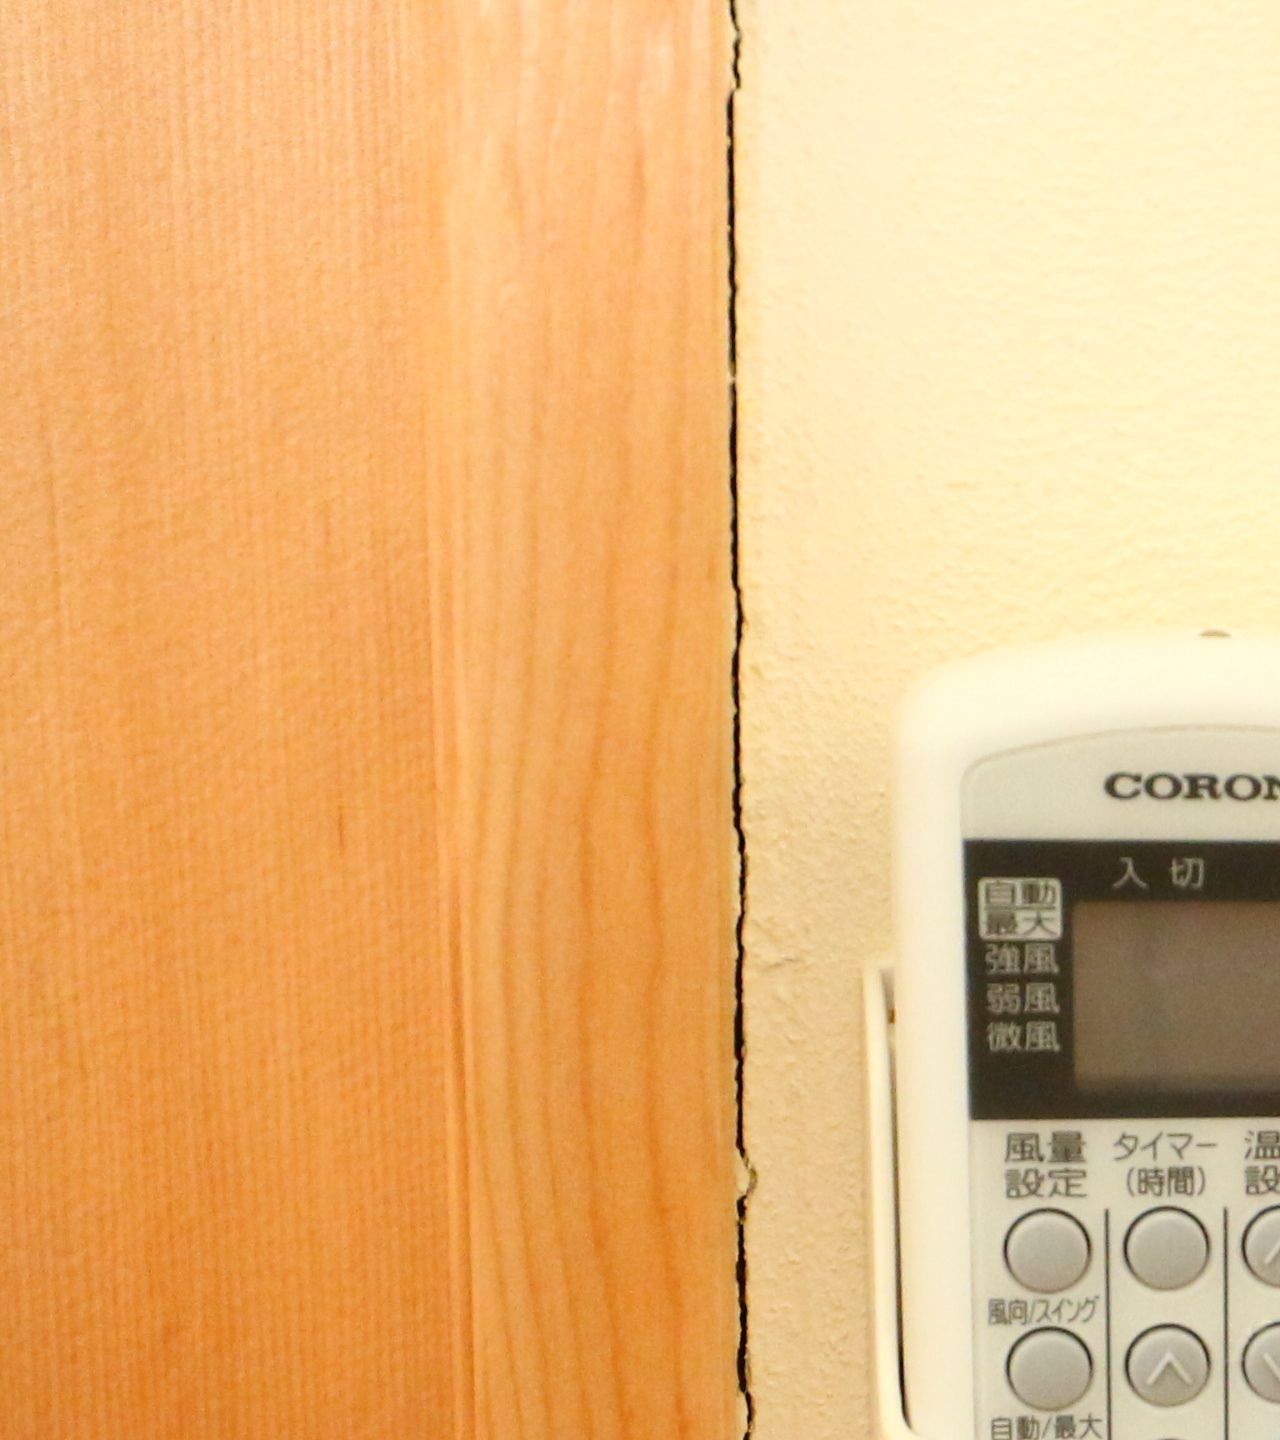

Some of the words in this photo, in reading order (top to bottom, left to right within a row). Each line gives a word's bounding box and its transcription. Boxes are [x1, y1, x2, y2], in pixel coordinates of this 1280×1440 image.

[1112, 857, 1149, 890] 入
[1170, 856, 1206, 888] 切
[985, 880, 1056, 905] 自動
[985, 908, 1058, 937] 最大
[984, 943, 1059, 975] 強風
[986, 983, 1060, 1015] 弱風
[986, 1021, 1061, 1053] 微風
[1004, 1130, 1087, 1163] 風量
[1113, 1132, 1218, 1161] タイマー
[1005, 1166, 1088, 1198] 設定
[1126, 1165, 1206, 1197] (時間)
[988, 1296, 1101, 1326] 風向/スイング
